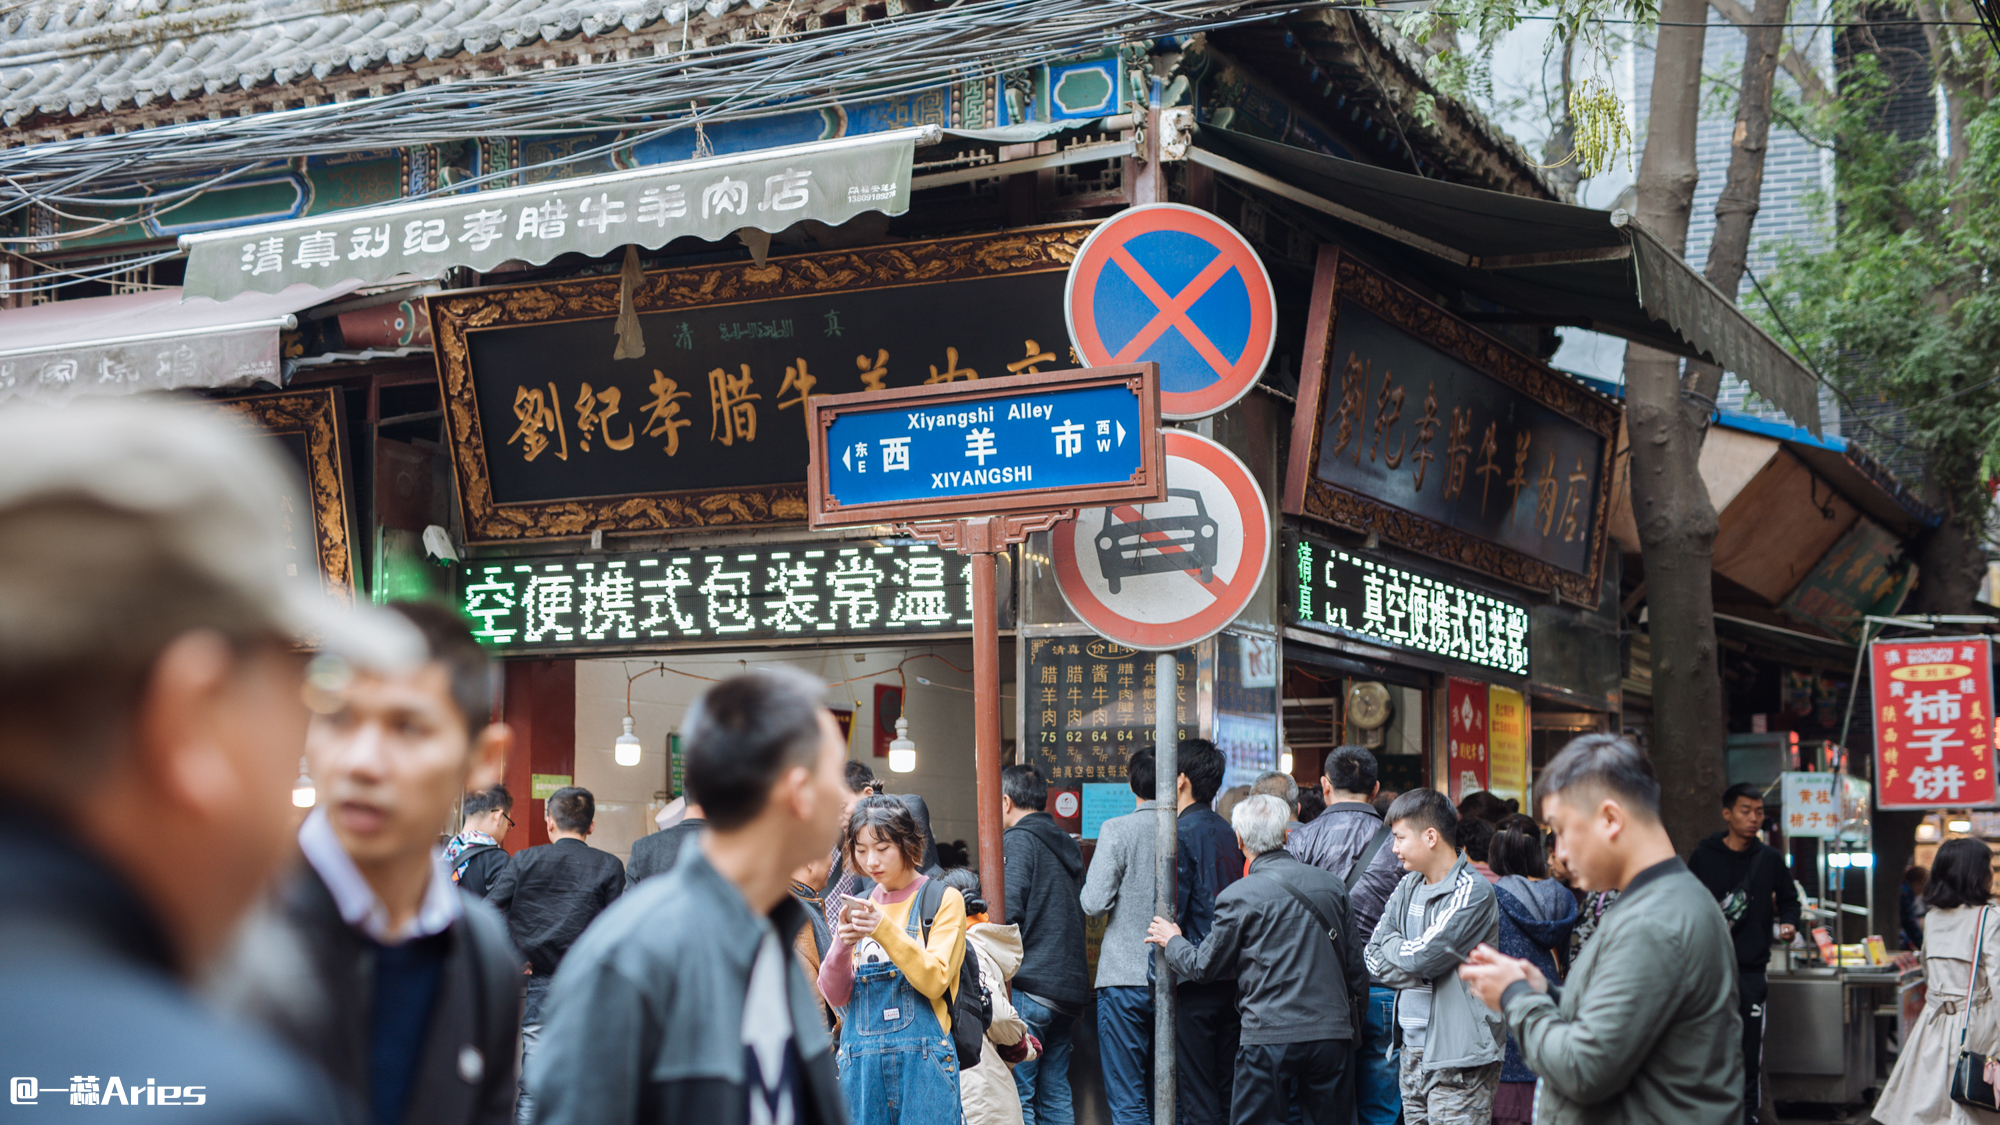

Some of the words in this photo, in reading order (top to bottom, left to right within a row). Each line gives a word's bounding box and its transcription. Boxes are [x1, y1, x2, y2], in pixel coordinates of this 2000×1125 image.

[241, 168, 812, 276] 清真刘纪孝腊牛羊肉店
[823, 308, 846, 338] 真
[673, 322, 694, 350] 清
[907, 406, 994, 431] Xiyangshi
[1008, 402, 1053, 420] Alley
[1096, 420, 1110, 435] 西
[855, 442, 868, 458] 东
[879, 419, 1085, 473] 西羊市
[1097, 439, 1111, 452] W
[858, 461, 866, 473] E
[931, 465, 1032, 489] XIYANGSHI
[1298, 541, 1313, 621] 清真
[465, 553, 972, 643] 空便携式包装常温
[1052, 643, 1080, 655] 清真
[1041, 666, 1057, 727] 腊羊肉
[1066, 665, 1083, 726] 腊牛肉
[1092, 664, 1109, 726] 酱牛肉
[1117, 663, 1134, 726] 腊牛肉腱子
[1041, 731, 1056, 742] 75
[1066, 731, 1082, 742] 62
[1092, 730, 1107, 742] 64
[1117, 730, 1133, 741] 64
[1904, 689, 1966, 800] 柿子饼
[1969, 700, 1986, 781] 美味可口
[1041, 746, 1057, 763] 元/斤
[1067, 746, 1083, 762] 元/斤
[1092, 745, 1109, 762] 元/斤
[1881, 705, 1899, 788] 陕西特产
[1052, 765, 1128, 778] 抽真空包装每袋
[1799, 789, 1831, 805] 黄桂
[1789, 811, 1839, 828] 柿子饼
